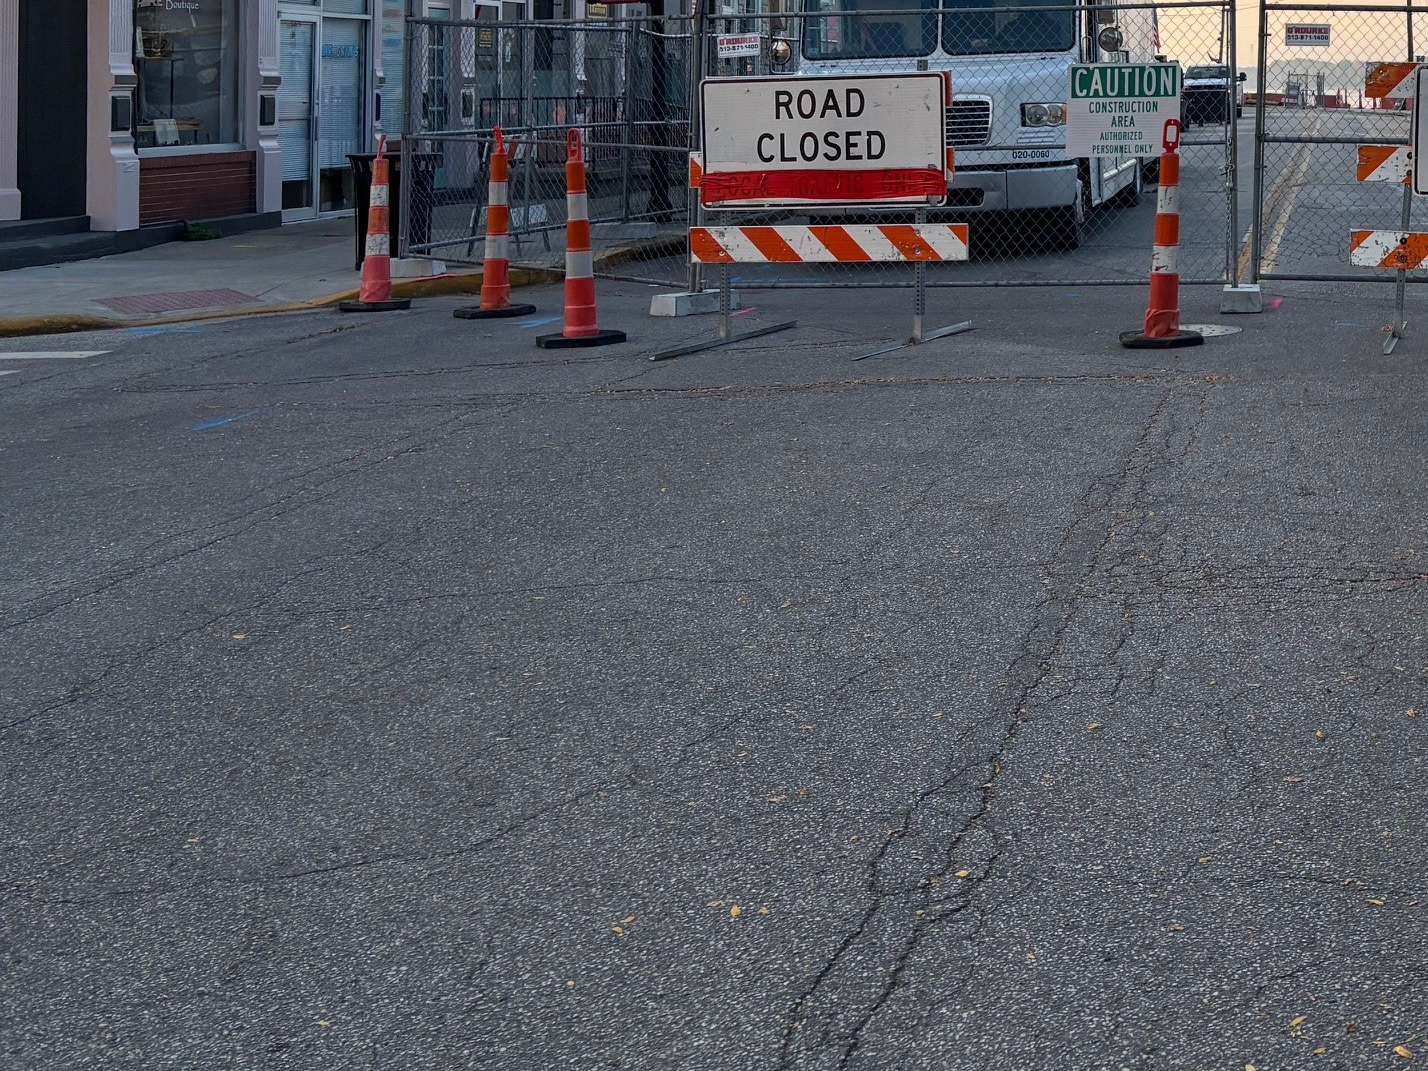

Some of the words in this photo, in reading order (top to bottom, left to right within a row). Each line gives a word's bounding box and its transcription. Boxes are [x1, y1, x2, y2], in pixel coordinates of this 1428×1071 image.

[1287, 26, 1329, 34] O'ROURKE
[1075, 67, 1173, 97] CAUTION
[775, 88, 865, 120] ROAD
[1089, 101, 1158, 114] CONSTRUCTION
[1111, 115, 1135, 127] AREA
[1099, 131, 1143, 141] AUTHORIZED
[757, 130, 886, 163] CLOSED
[1092, 144, 1132, 154] PERSONNEL
[1134, 144, 1153, 154] ONLY
[1012, 150, 1050, 159] 020-0060
